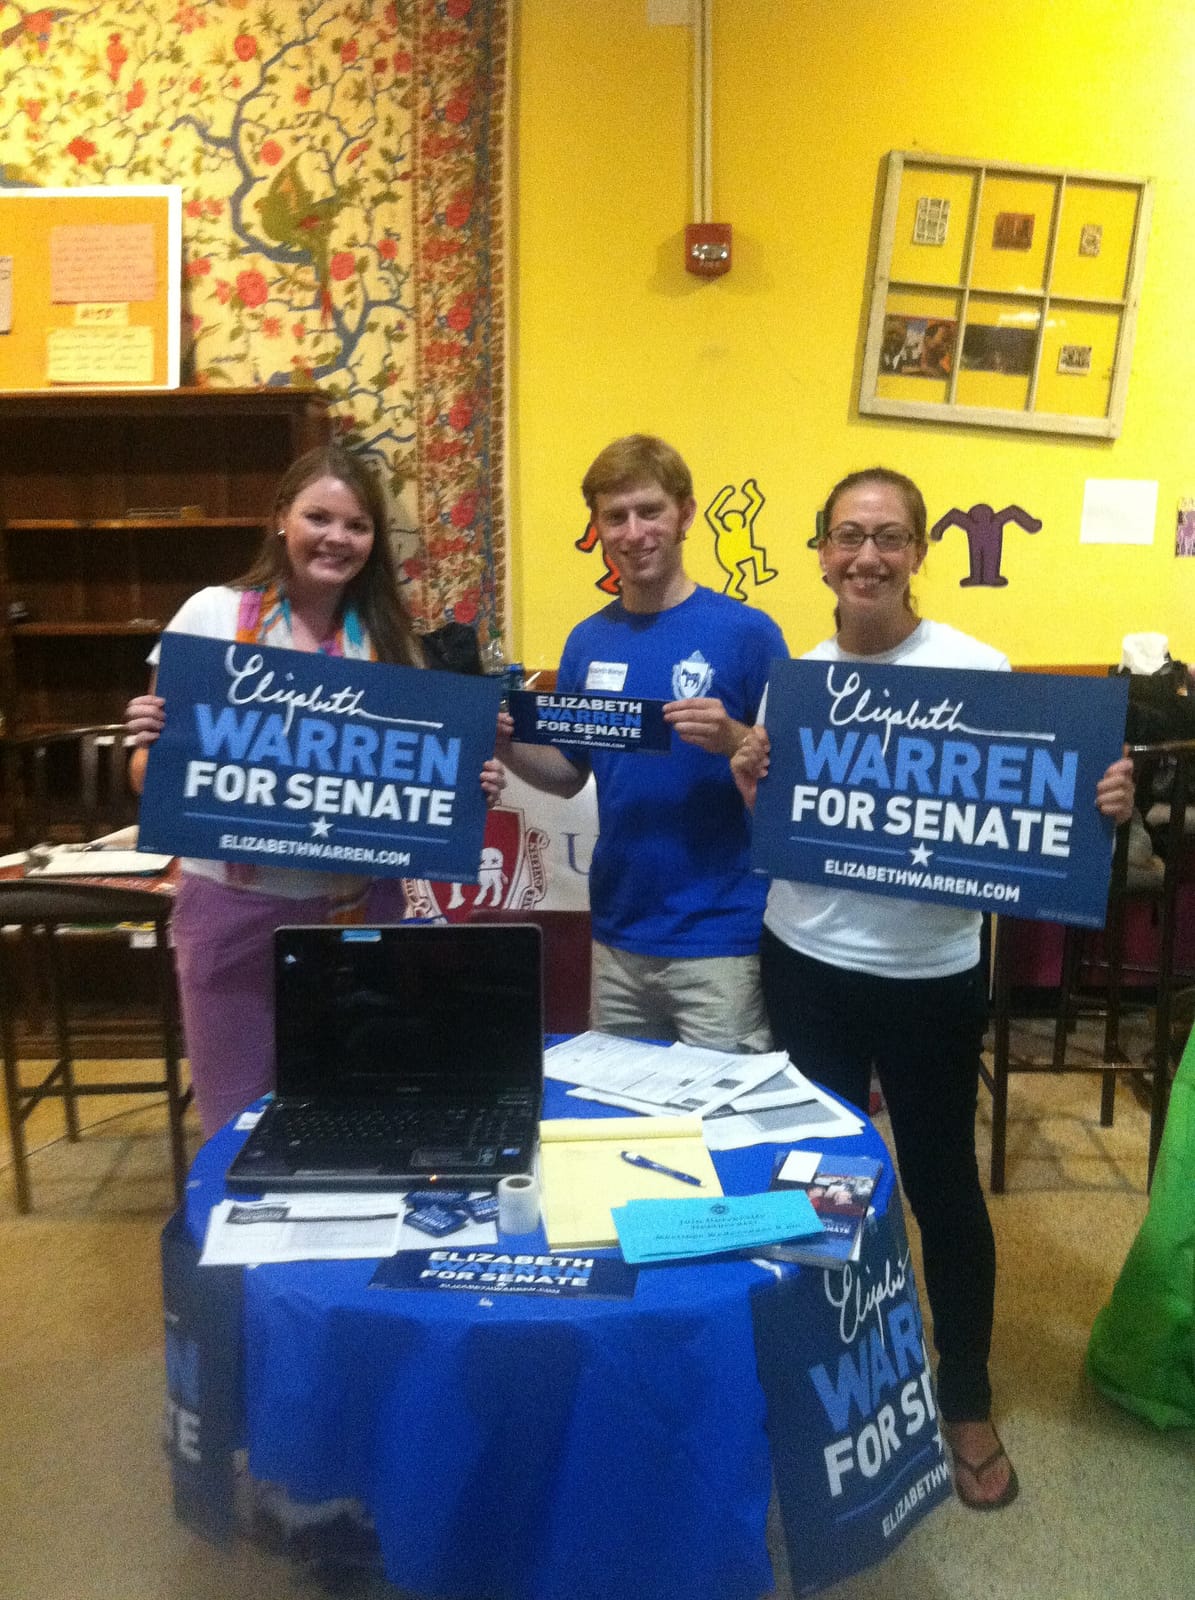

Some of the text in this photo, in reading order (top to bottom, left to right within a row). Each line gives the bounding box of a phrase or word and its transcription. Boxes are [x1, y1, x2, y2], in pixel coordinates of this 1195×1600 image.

[225, 645, 443, 736] Elizabeth
[536, 695, 643, 714] ELIZABETH
[537, 707, 642, 728] WARREN
[827, 665, 1056, 757] Elizabeth
[195, 703, 461, 786] WARREN
[536, 720, 642, 739] FOR SENATE
[184, 760, 456, 826] FOR SENATE
[799, 727, 1079, 810] WARREN
[791, 784, 1073, 857] FOR SENATE
[218, 833, 411, 867] ELIZABETHWARREN.COM
[824, 858, 1020, 902] ELIZABETHWARREN.COM
[420, 1269, 589, 1287] FOR SENATE
[429, 1251, 594, 1268] ELIZABETH
[430, 1261, 593, 1279] WARREN
[808, 1301, 924, 1433] WAR
[823, 1405, 902, 1498] FOR
